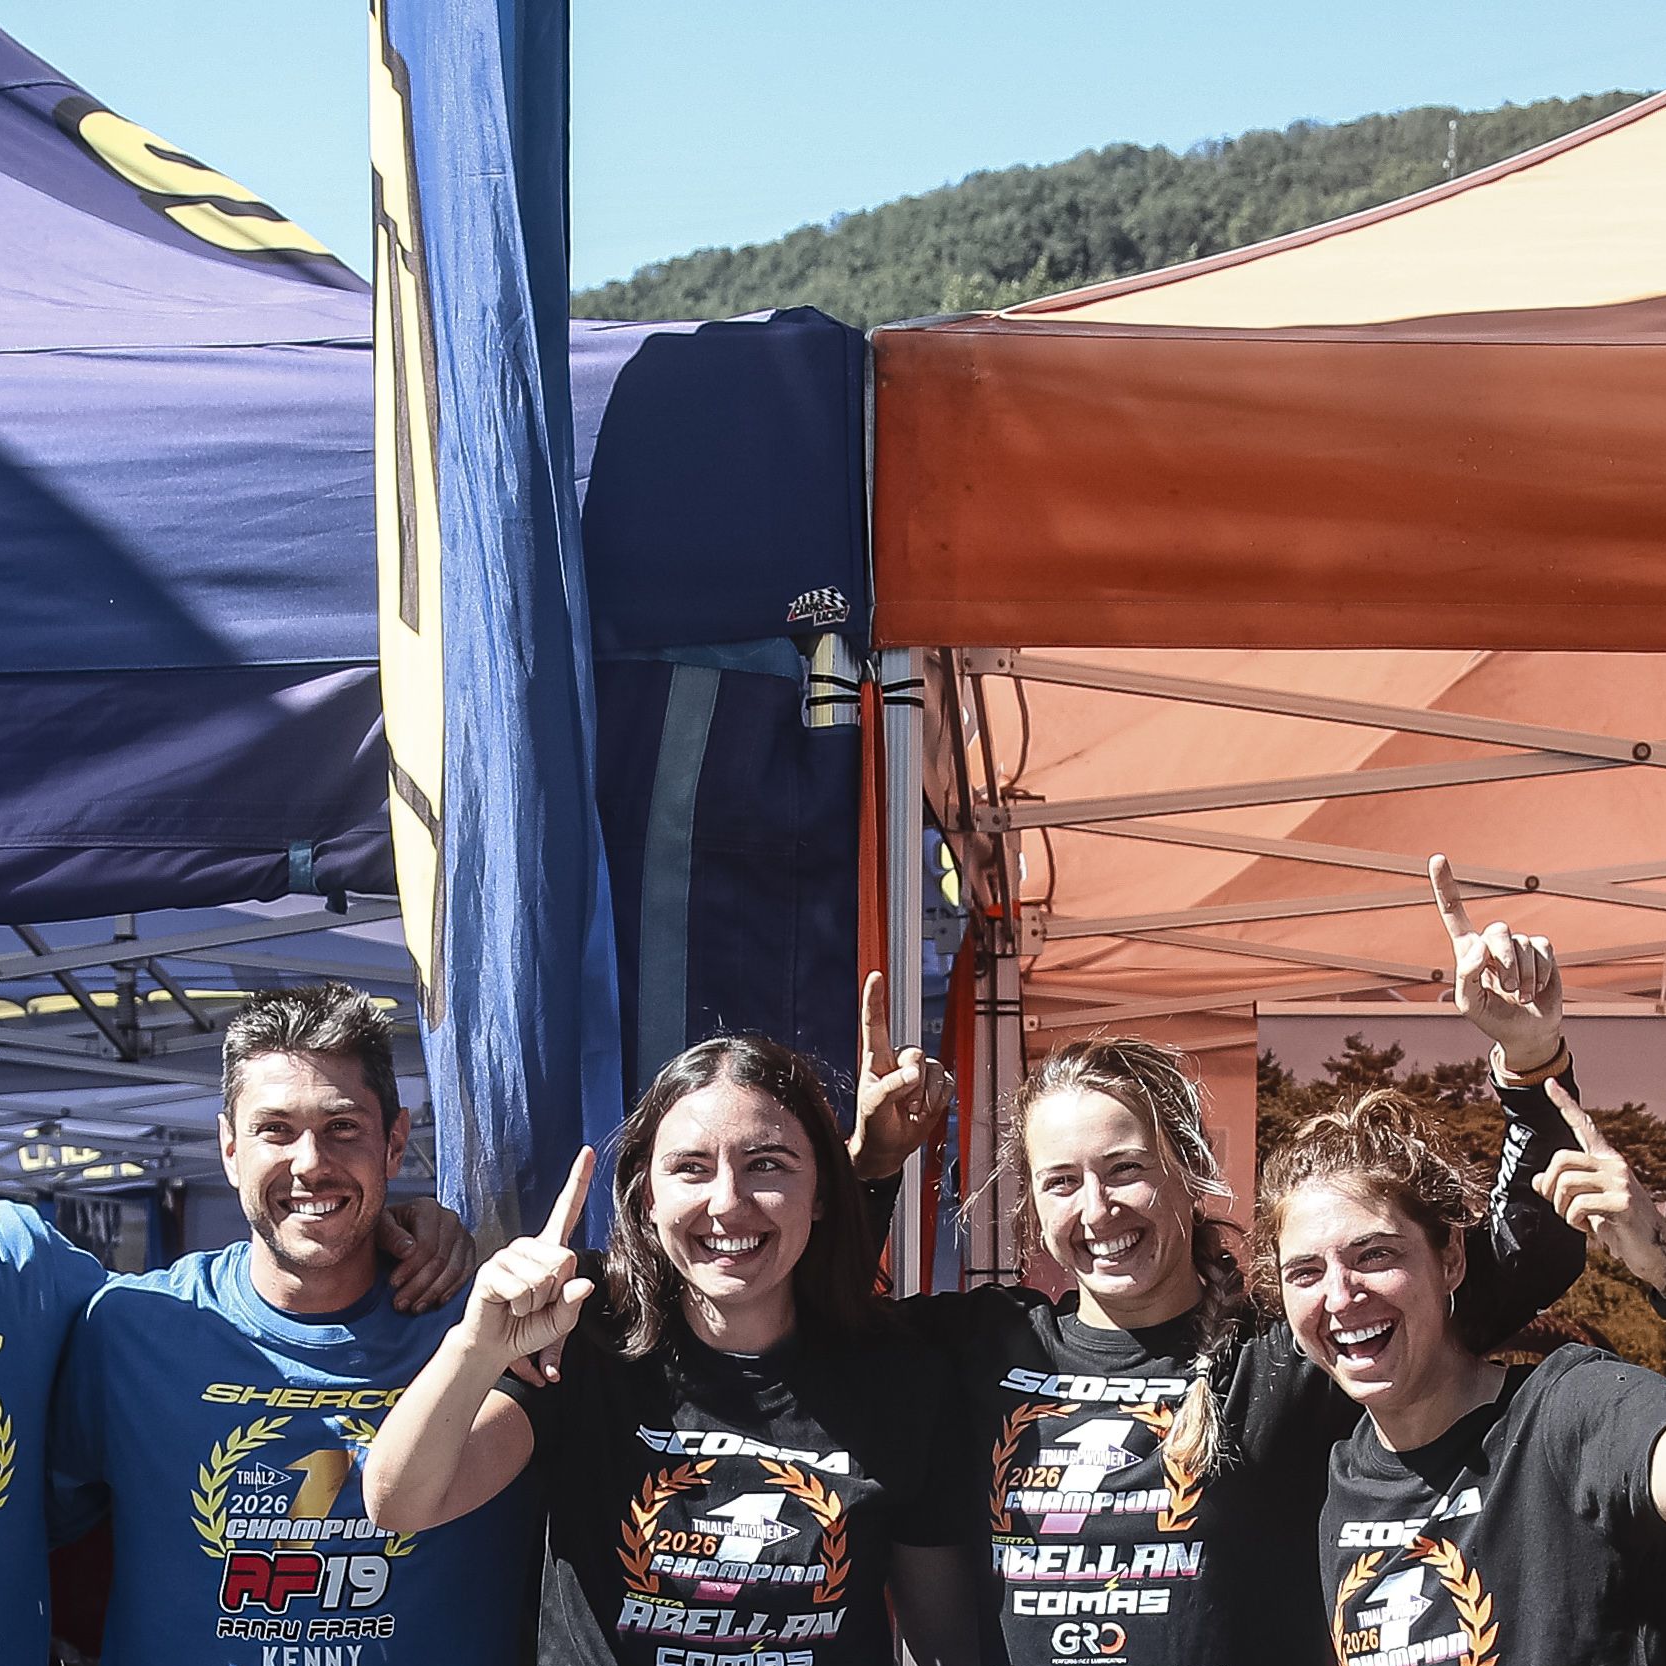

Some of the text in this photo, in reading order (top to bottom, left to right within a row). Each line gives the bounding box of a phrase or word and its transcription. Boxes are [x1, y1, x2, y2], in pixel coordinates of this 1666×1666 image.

[999, 1368, 1189, 1402] SCORP
[635, 1424, 851, 1475] SCORPA
[1040, 1448, 1126, 1467] TRIALGPWOMEN
[236, 1470, 275, 1486] TRIAL2
[1008, 1467, 1062, 1488] 2026
[229, 1494, 288, 1515] 2026
[1003, 1487, 1172, 1514] CHAMPION
[692, 1518, 783, 1540] TRIALGPWOMEN
[991, 1534, 1035, 1546] BERTA
[655, 1529, 718, 1556] 2026
[650, 1553, 827, 1586] CHAMPION
[992, 1541, 1205, 1581] ABELLAN
[626, 1591, 685, 1608] BERTA
[1012, 1588, 1171, 1616] COMAS
[616, 1597, 848, 1644] ABELLAN
[1342, 1631, 1380, 1655] 2026
